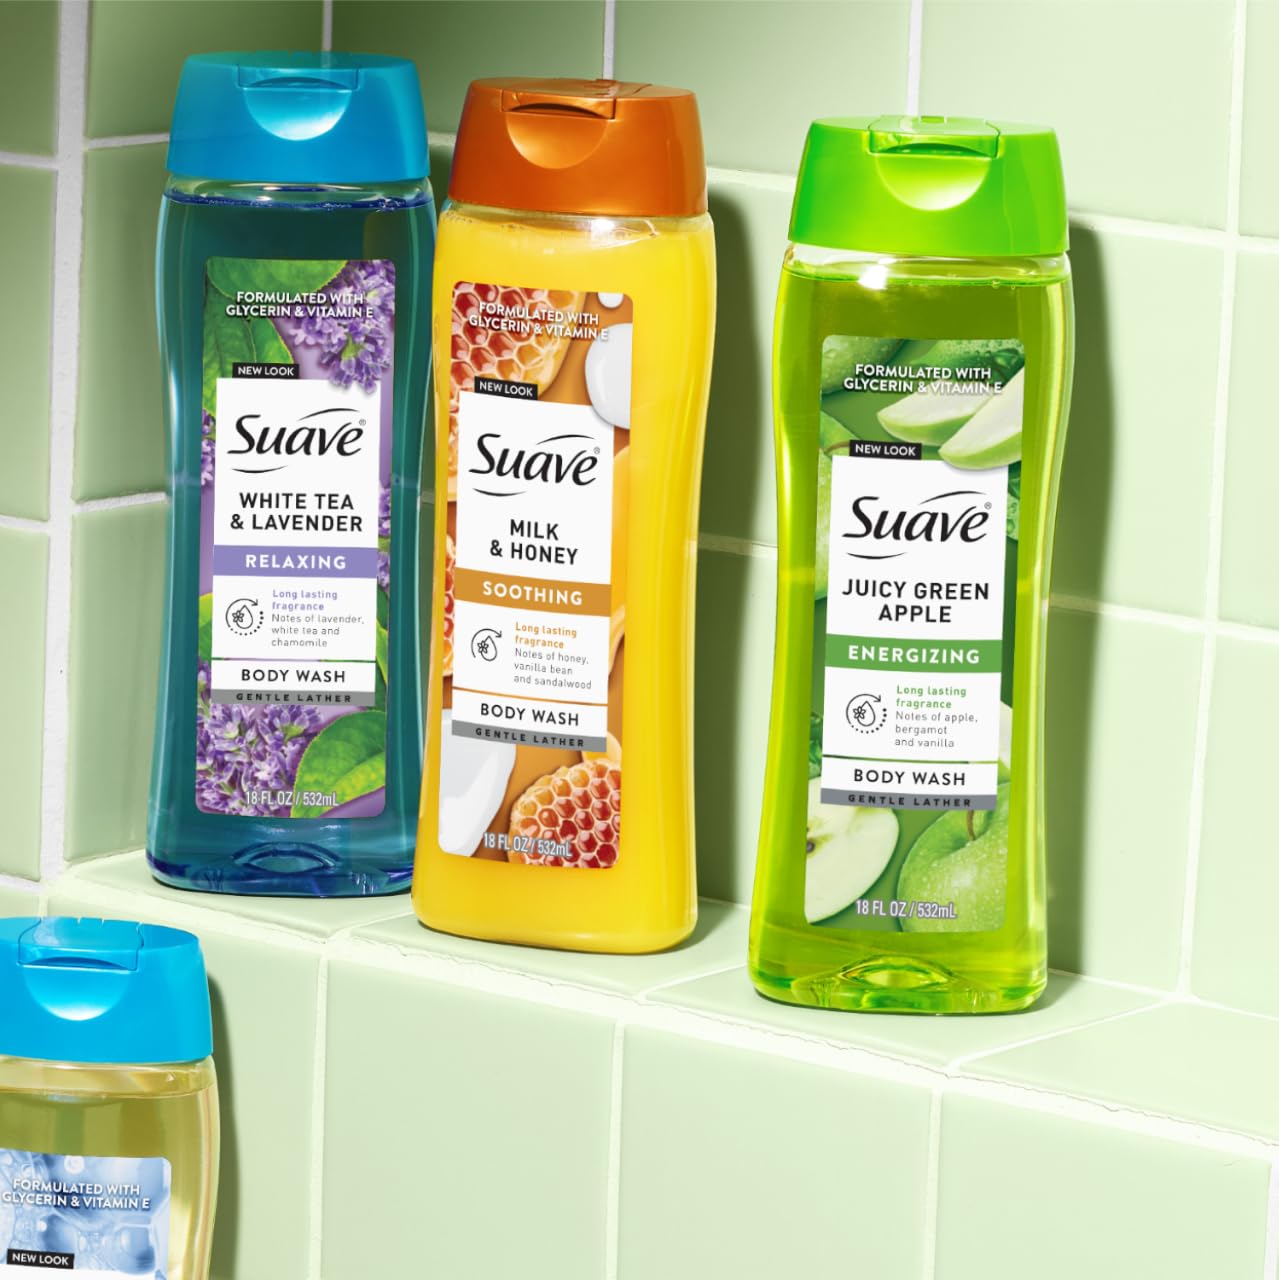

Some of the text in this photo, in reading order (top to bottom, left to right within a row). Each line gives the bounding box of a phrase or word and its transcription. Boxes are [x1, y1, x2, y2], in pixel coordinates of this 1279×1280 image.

[237, 292, 363, 304] FORMULATED WITH
[226, 305, 373, 317] GLYCERIN & VITAMIN E
[238, 367, 294, 375] NEW LOOK
[856, 364, 991, 379] FORMULATED WITH
[480, 381, 533, 397] NEW LOOK
[844, 378, 1002, 394] GLYCERIN & VITAMIN E
[227, 414, 364, 456] Suave
[856, 444, 916, 456] NEW LOOK
[469, 433, 598, 486] Suave
[240, 493, 354, 509] WHITE TEA
[230, 514, 362, 532] & LAVENDER
[842, 496, 989, 542] Suave
[510, 519, 558, 540] MILK
[490, 540, 577, 564] & HONEY
[245, 555, 346, 570] RELAXING
[273, 590, 337, 600] Long lasting
[483, 581, 582, 605] SOOTHING
[842, 579, 989, 600] JUICY GREEN
[272, 602, 324, 611] fragrance
[879, 605, 951, 622] APPLE
[848, 645, 980, 664] ENERGIZING
[241, 669, 345, 682] BODY WASH
[236, 693, 351, 702] GENTLE LATHER
[897, 685, 966, 697] Long lasting
[896, 699, 951, 709] fragrance
[481, 703, 579, 726] BODY WASH
[896, 711, 978, 723] Notes of apple,
[476, 728, 584, 747] GENTLE LATHER
[896, 725, 947, 735] bergamot
[895, 738, 954, 748] and vanilla
[854, 769, 966, 786] BODY WASH
[848, 794, 971, 806] GENTLE LATHER
[13, 1179, 140, 1195] FORMULATED WITH
[12, 1253, 69, 1265] NEW LOOK
